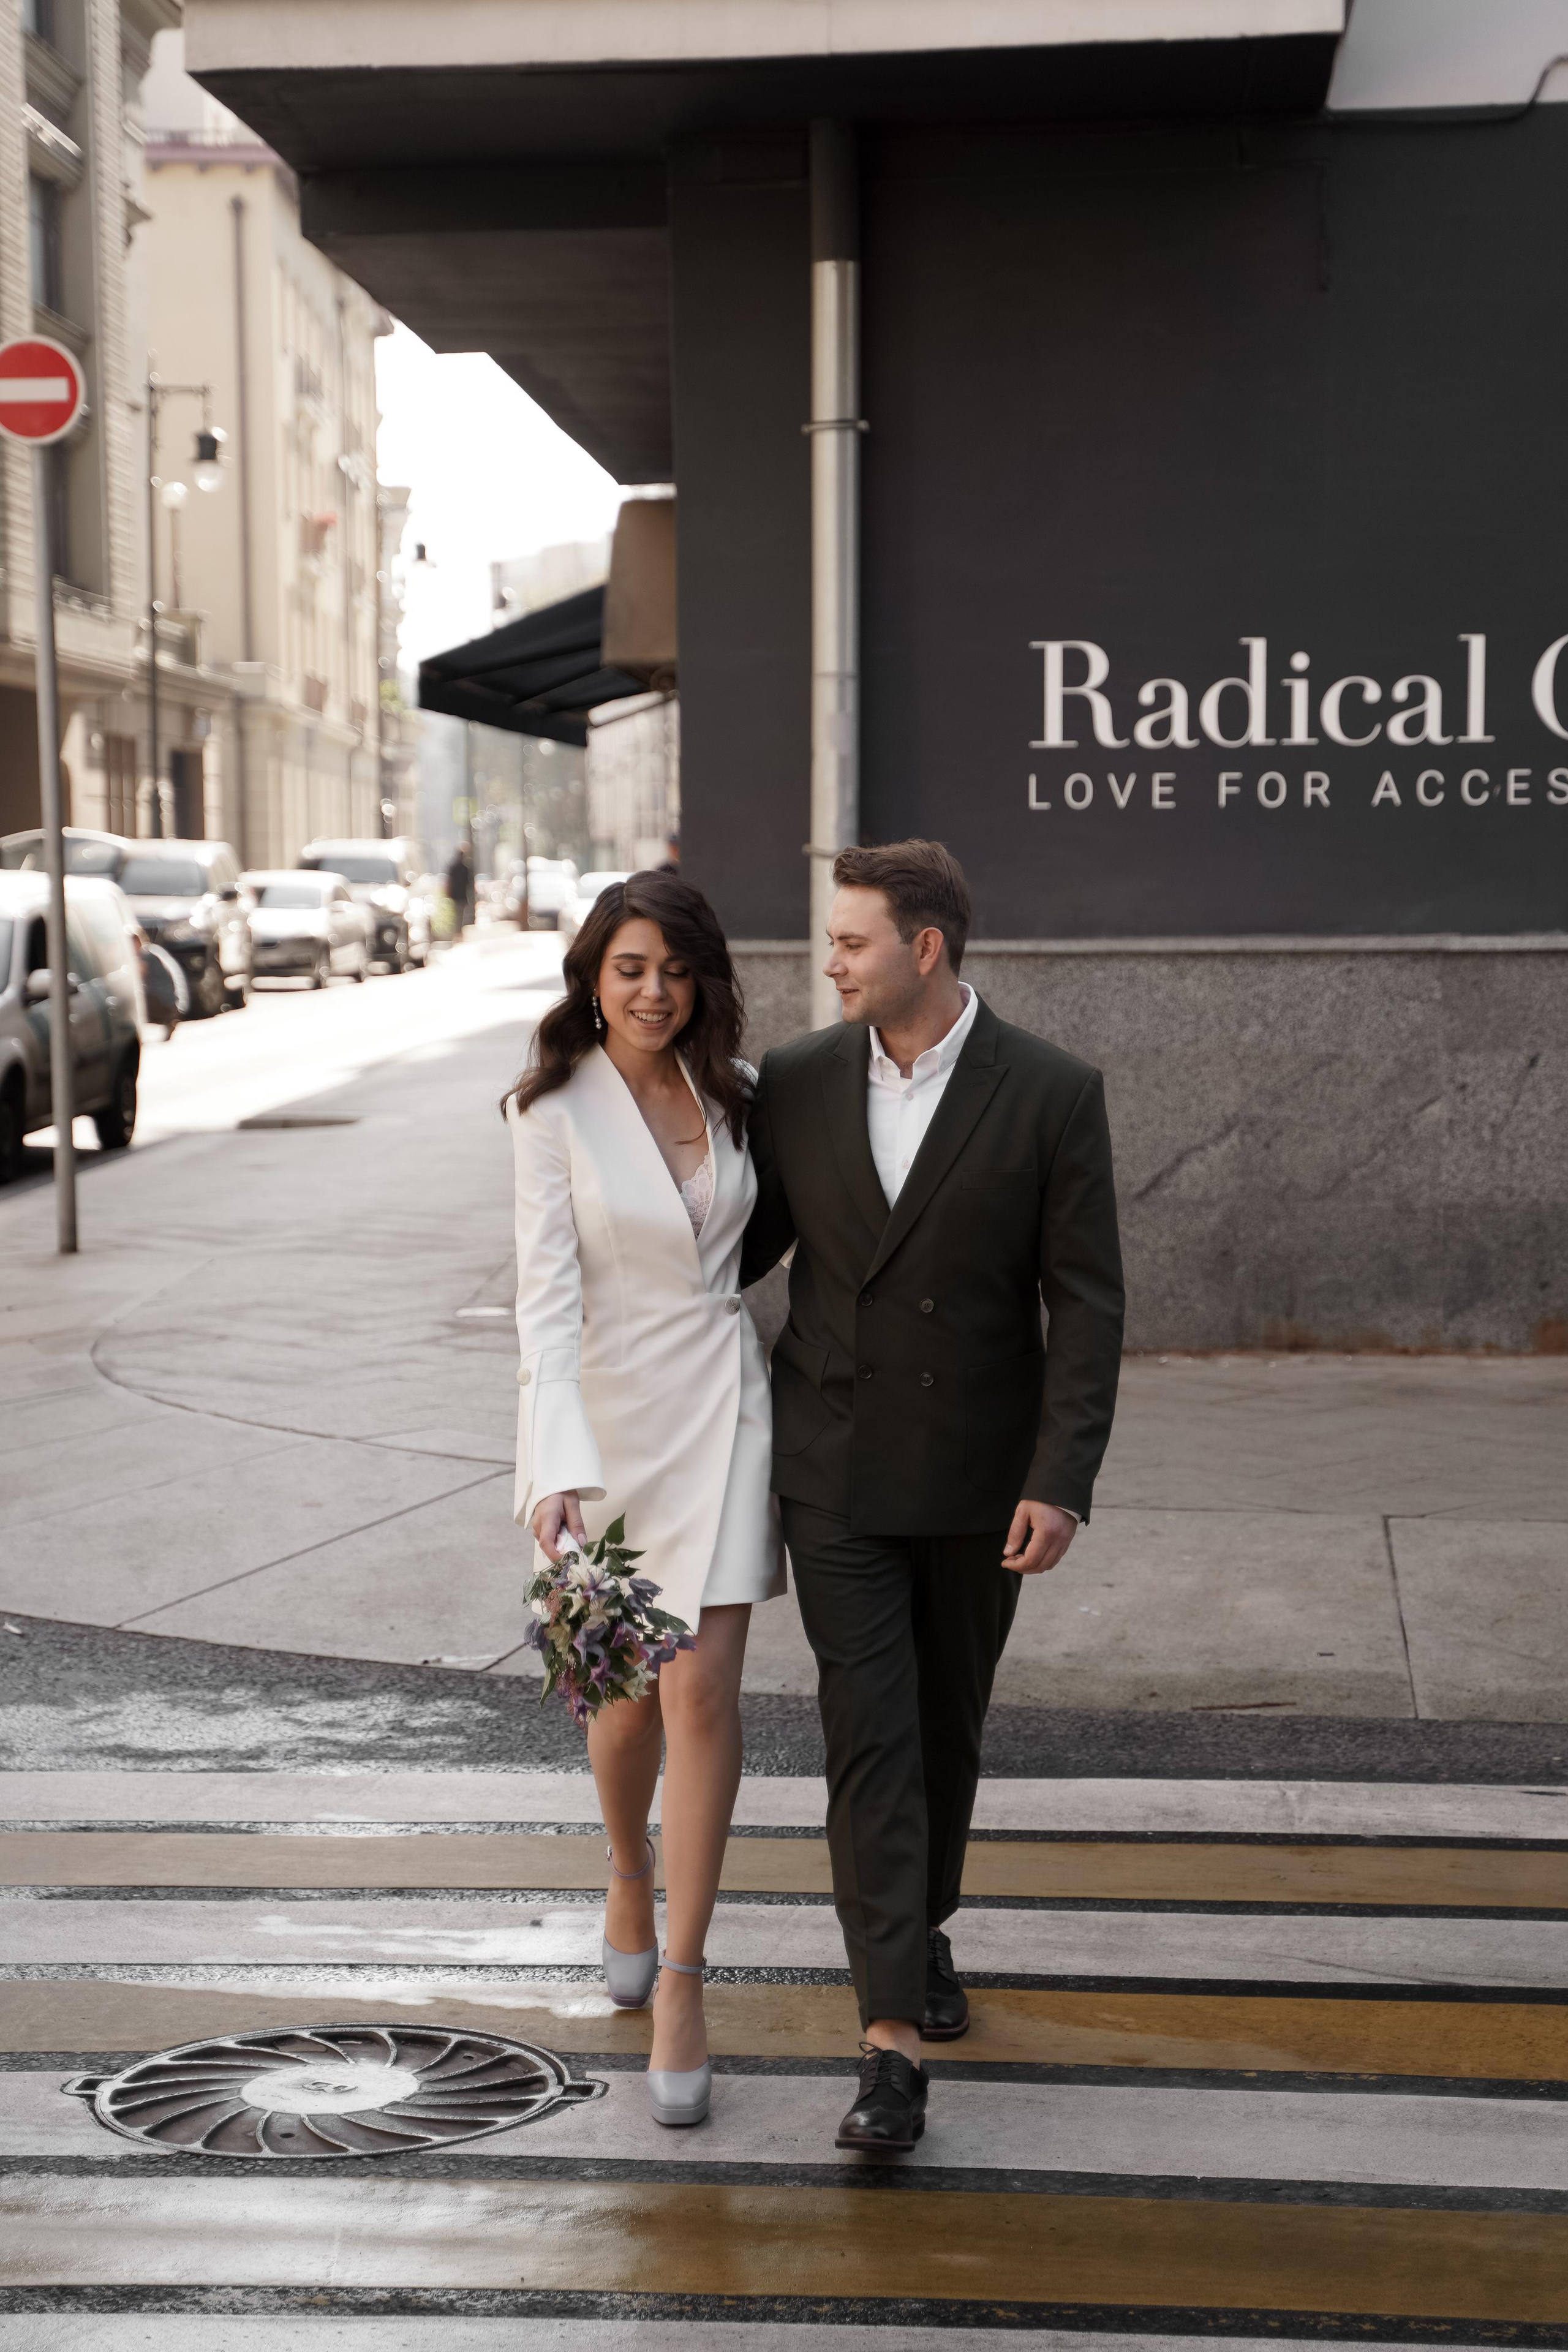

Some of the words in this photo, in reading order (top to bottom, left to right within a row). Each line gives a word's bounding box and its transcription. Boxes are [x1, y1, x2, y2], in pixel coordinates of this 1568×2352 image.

[1028, 633, 1496, 749] Radical
[1028, 772, 1177, 810] LOVE
[1218, 771, 1330, 809] FOR
[1371, 767, 1568, 807] ACCES
